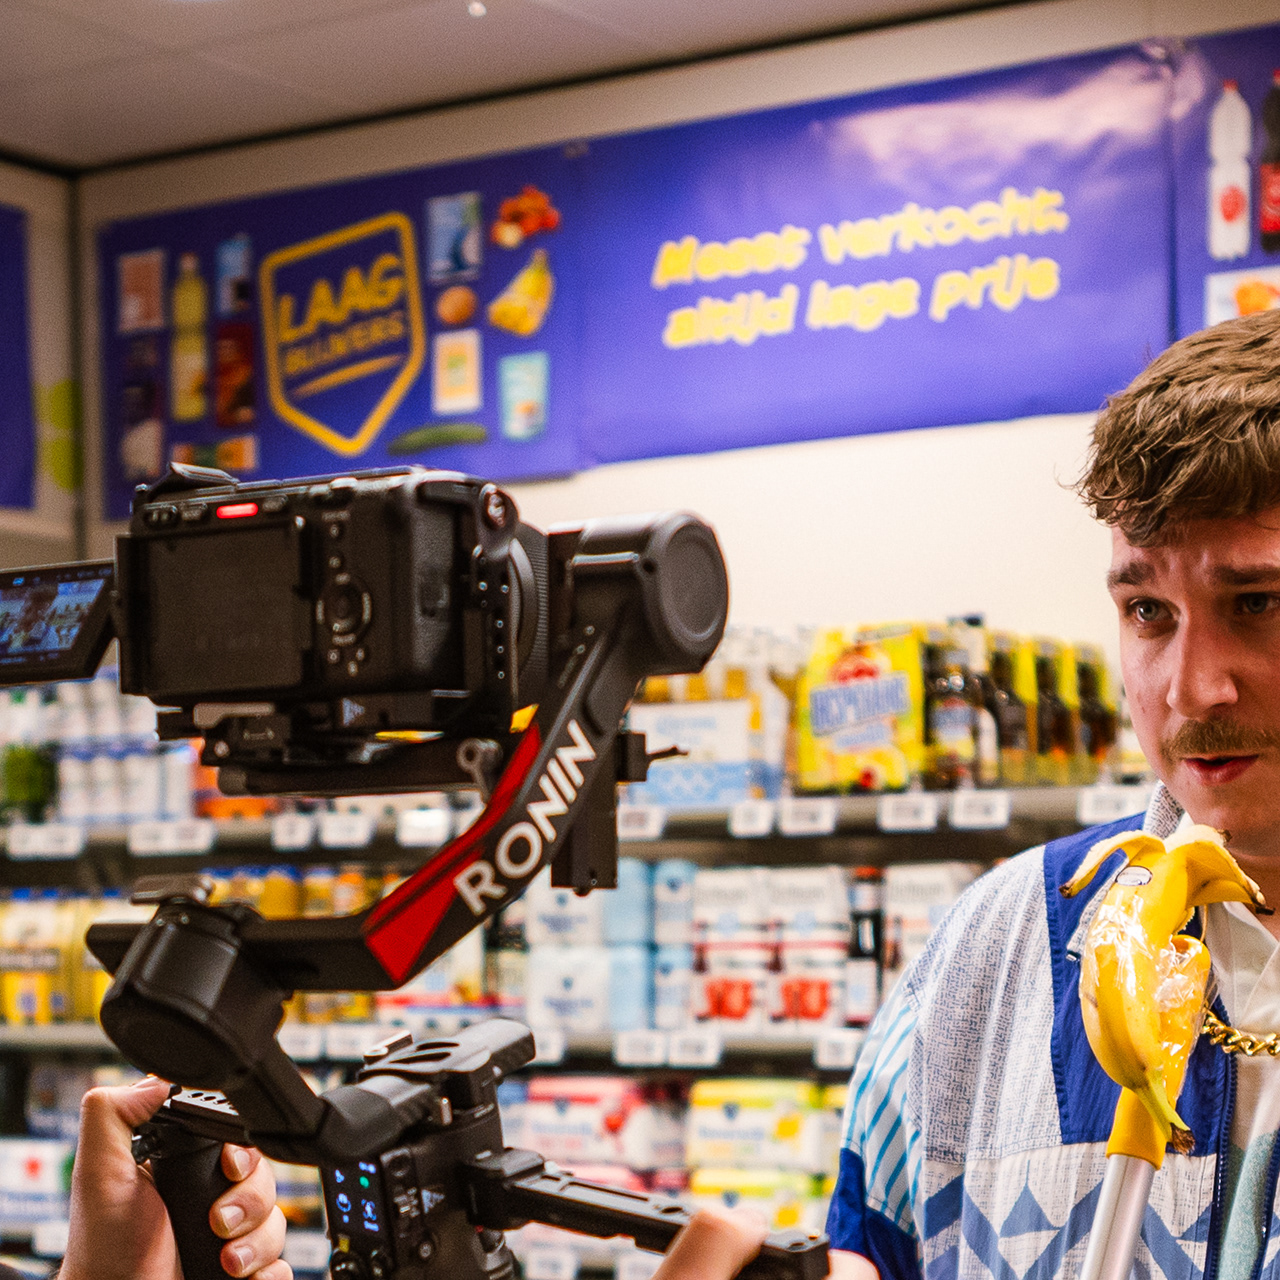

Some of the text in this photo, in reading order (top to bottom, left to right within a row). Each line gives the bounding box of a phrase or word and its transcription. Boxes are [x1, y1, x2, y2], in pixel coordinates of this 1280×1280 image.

[278, 253, 406, 345] LAAG
[651, 224, 811, 288] Meest
[663, 253, 1061, 349] altijd lage prijs
[453, 719, 597, 916] RONIN
